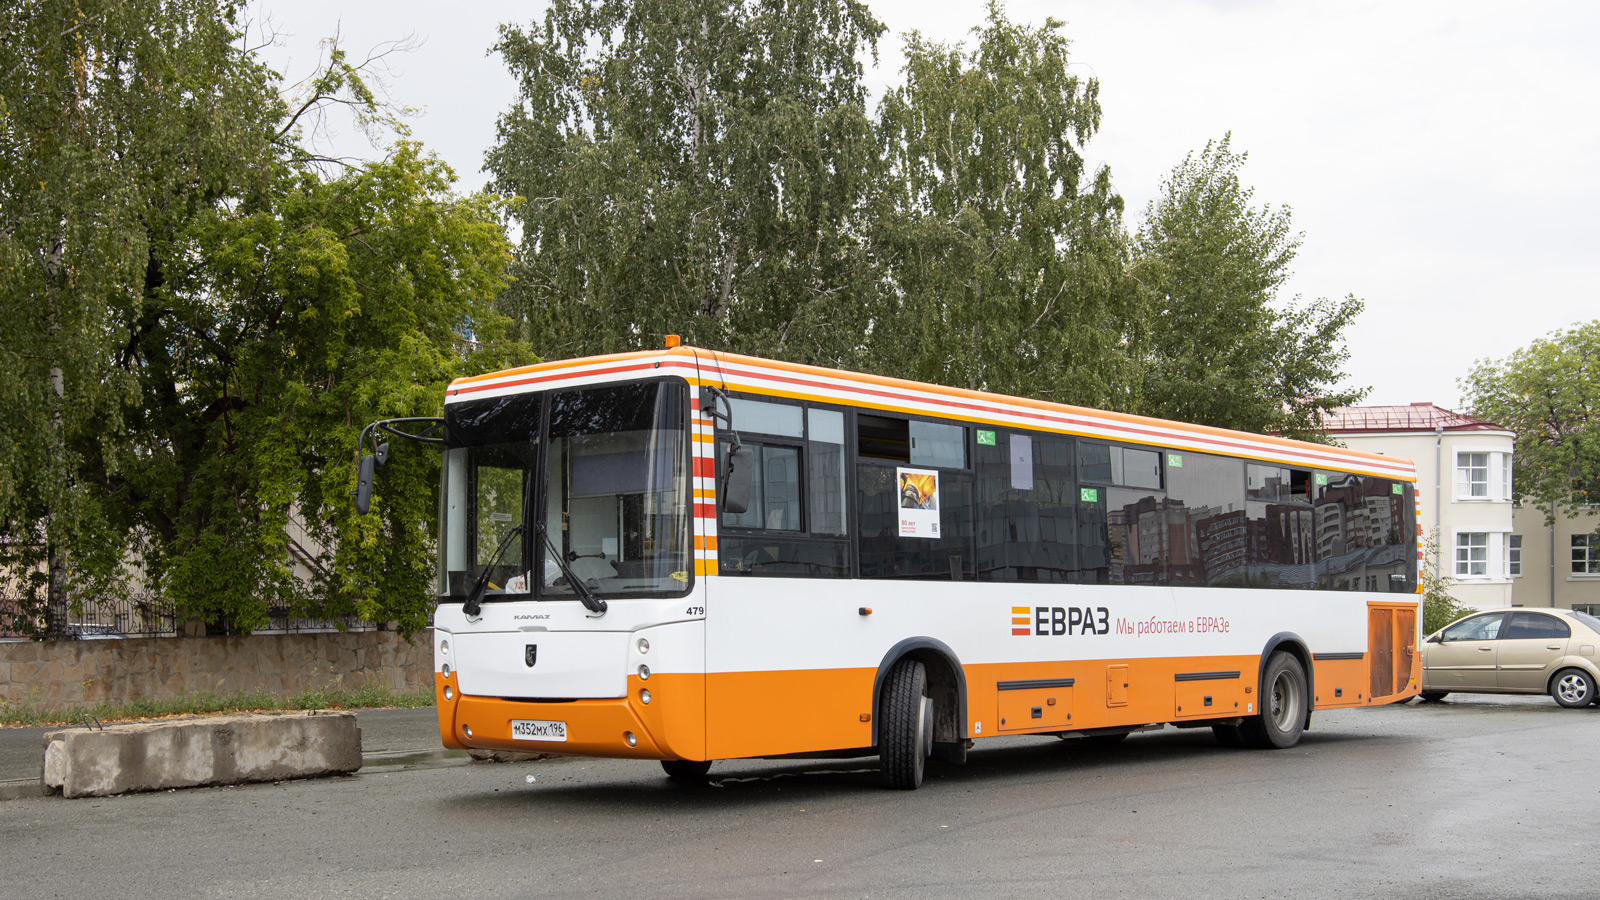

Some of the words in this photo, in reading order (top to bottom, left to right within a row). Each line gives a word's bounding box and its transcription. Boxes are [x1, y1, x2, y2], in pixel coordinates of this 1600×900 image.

[686, 606, 705, 616] 479
[1035, 606, 1110, 636] ЕВРАЗ
[1116, 617, 1135, 635] Мы
[1137, 615, 1187, 638] работаем
[1188, 620, 1195, 633] в
[1196, 616, 1230, 633] ЕВРАЗе
